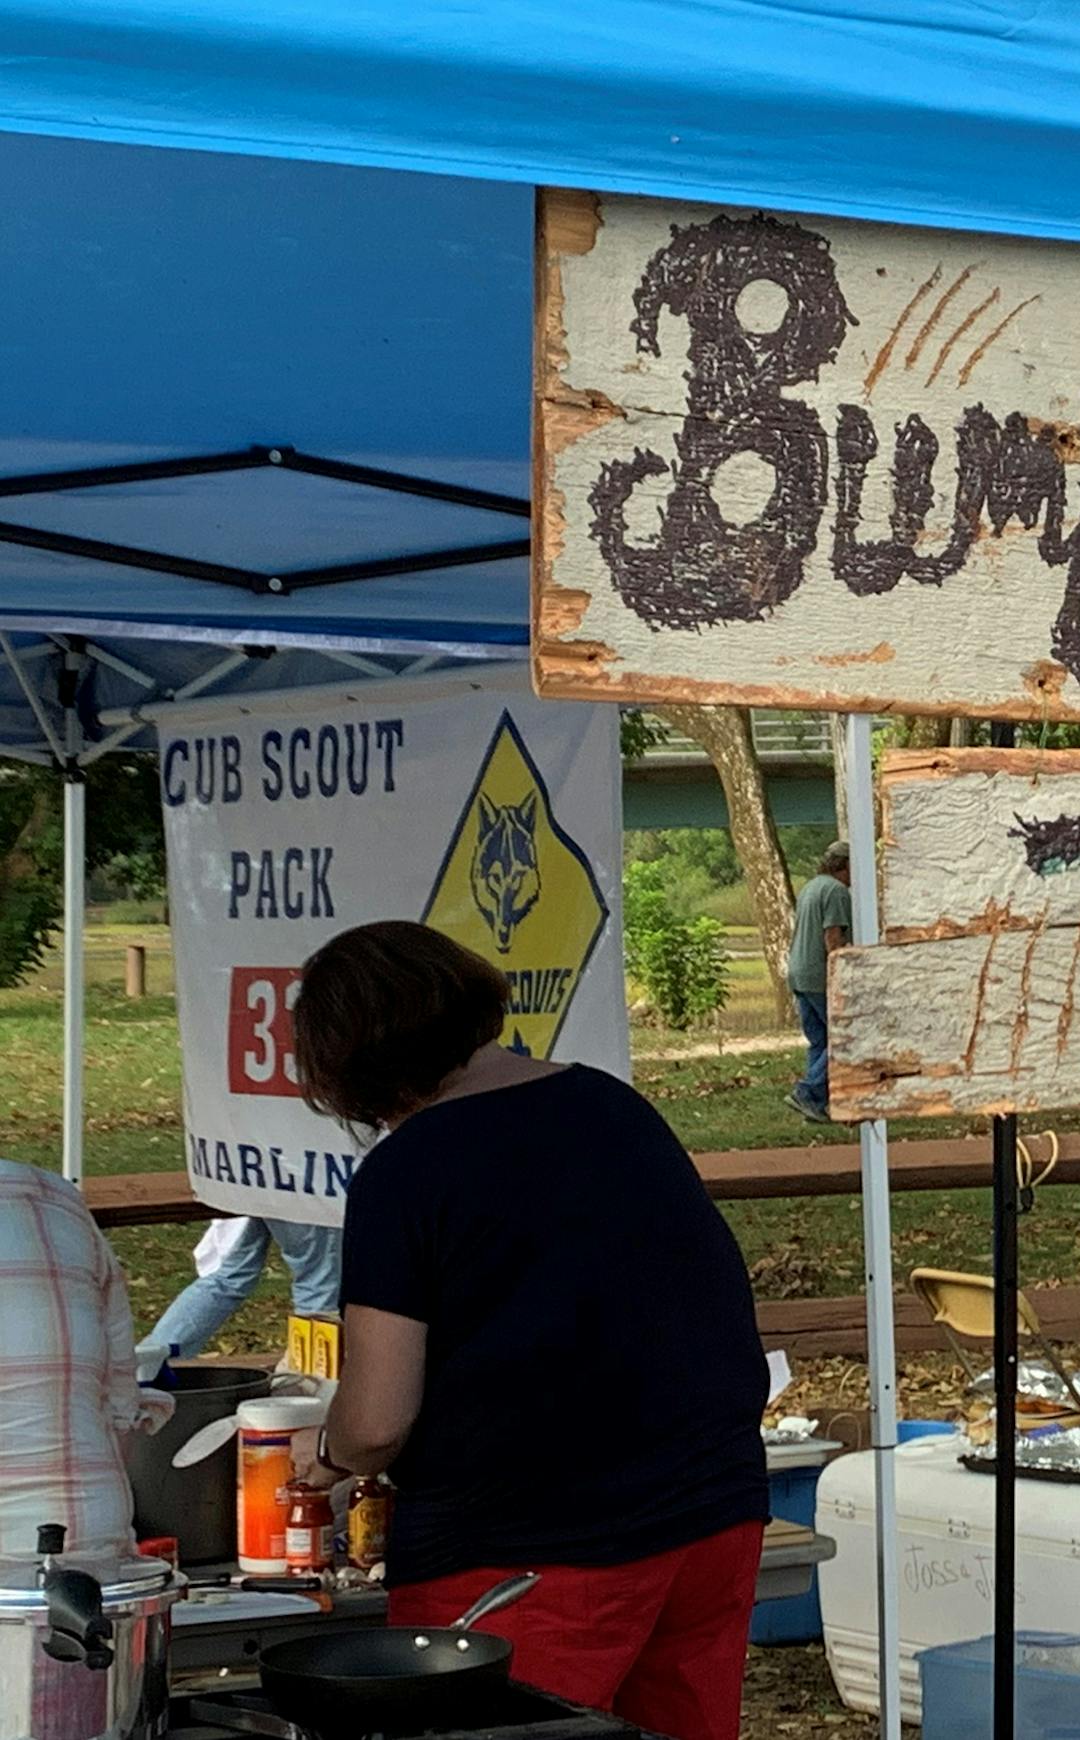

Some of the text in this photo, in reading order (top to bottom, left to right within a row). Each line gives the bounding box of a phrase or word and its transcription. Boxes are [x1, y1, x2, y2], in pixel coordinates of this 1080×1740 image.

[163, 719, 404, 807] CUB SCOUT
[228, 847, 335, 919] PACK
[505, 968, 573, 1015] COUTS
[190, 1133, 355, 1197] MARLIN
